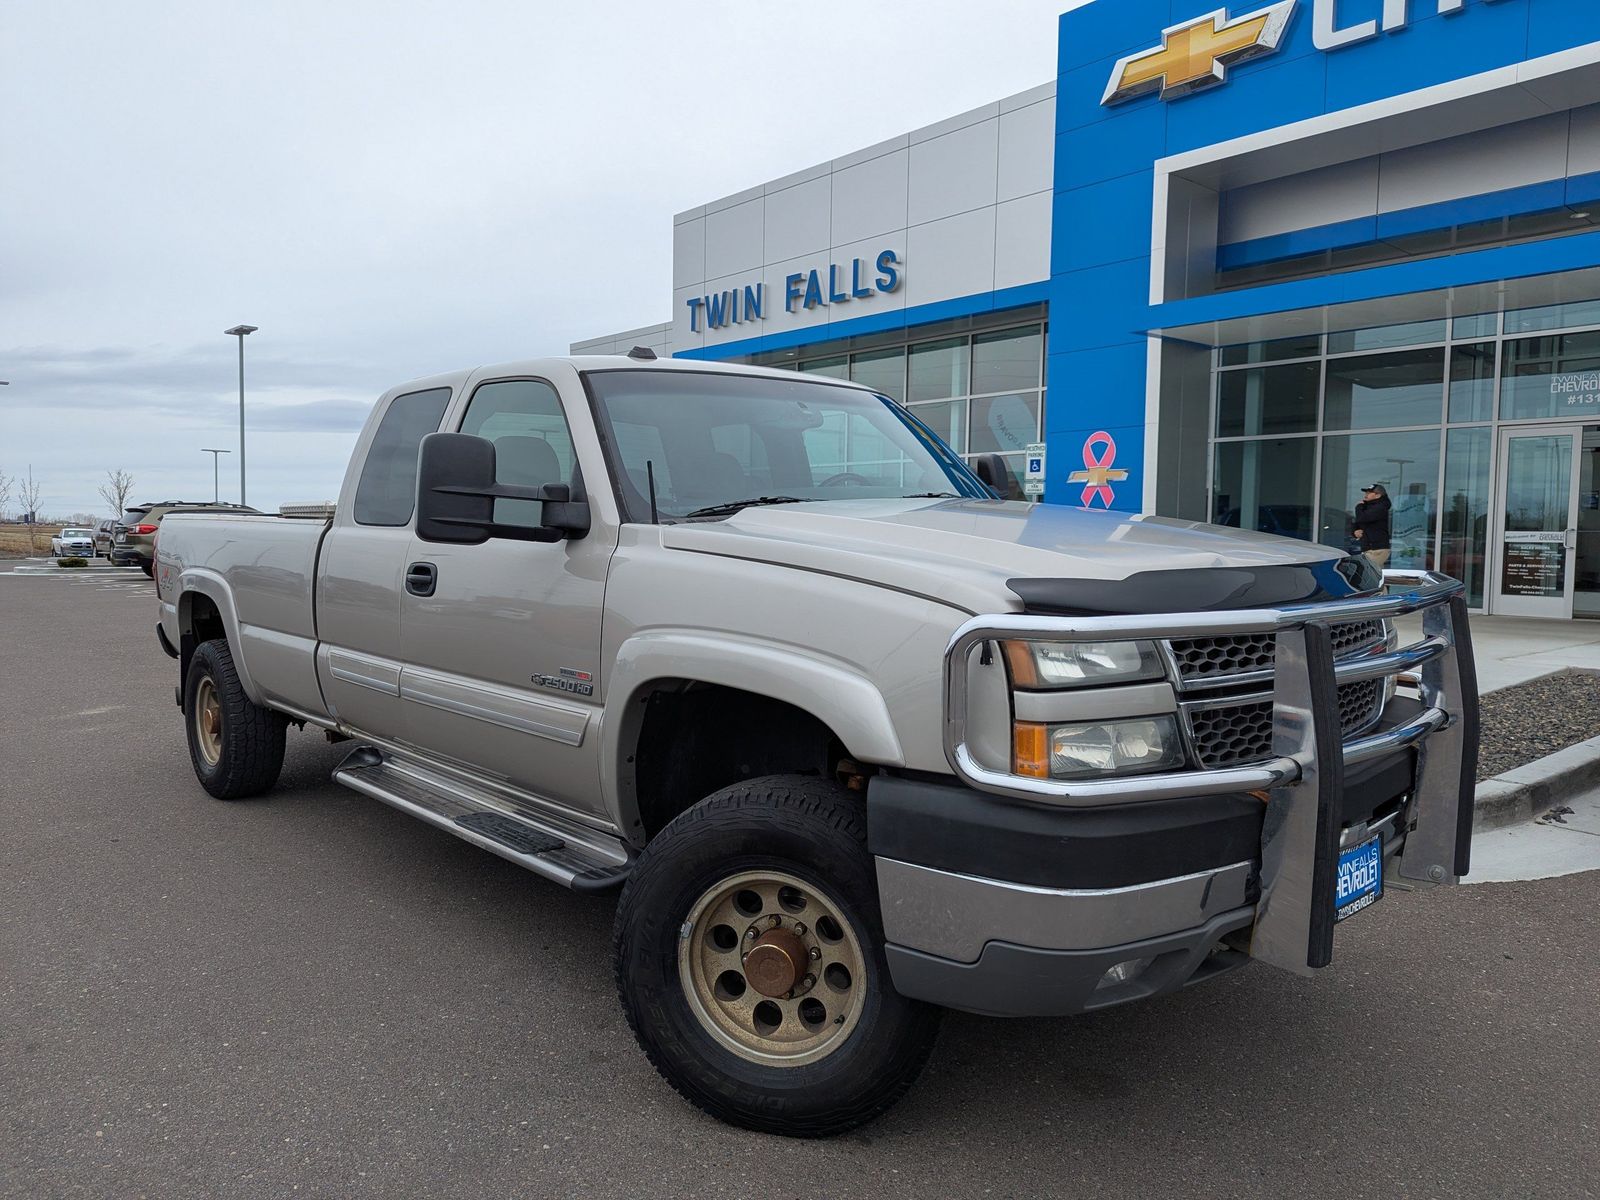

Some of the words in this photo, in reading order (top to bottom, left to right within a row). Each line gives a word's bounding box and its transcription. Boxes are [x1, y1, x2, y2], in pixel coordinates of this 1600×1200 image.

[687, 282, 765, 332] TWIN
[786, 249, 902, 312] FALLS
[545, 679, 575, 691] 2500
[576, 684, 590, 694] HD
[1336, 860, 1378, 899] HEVROLET
